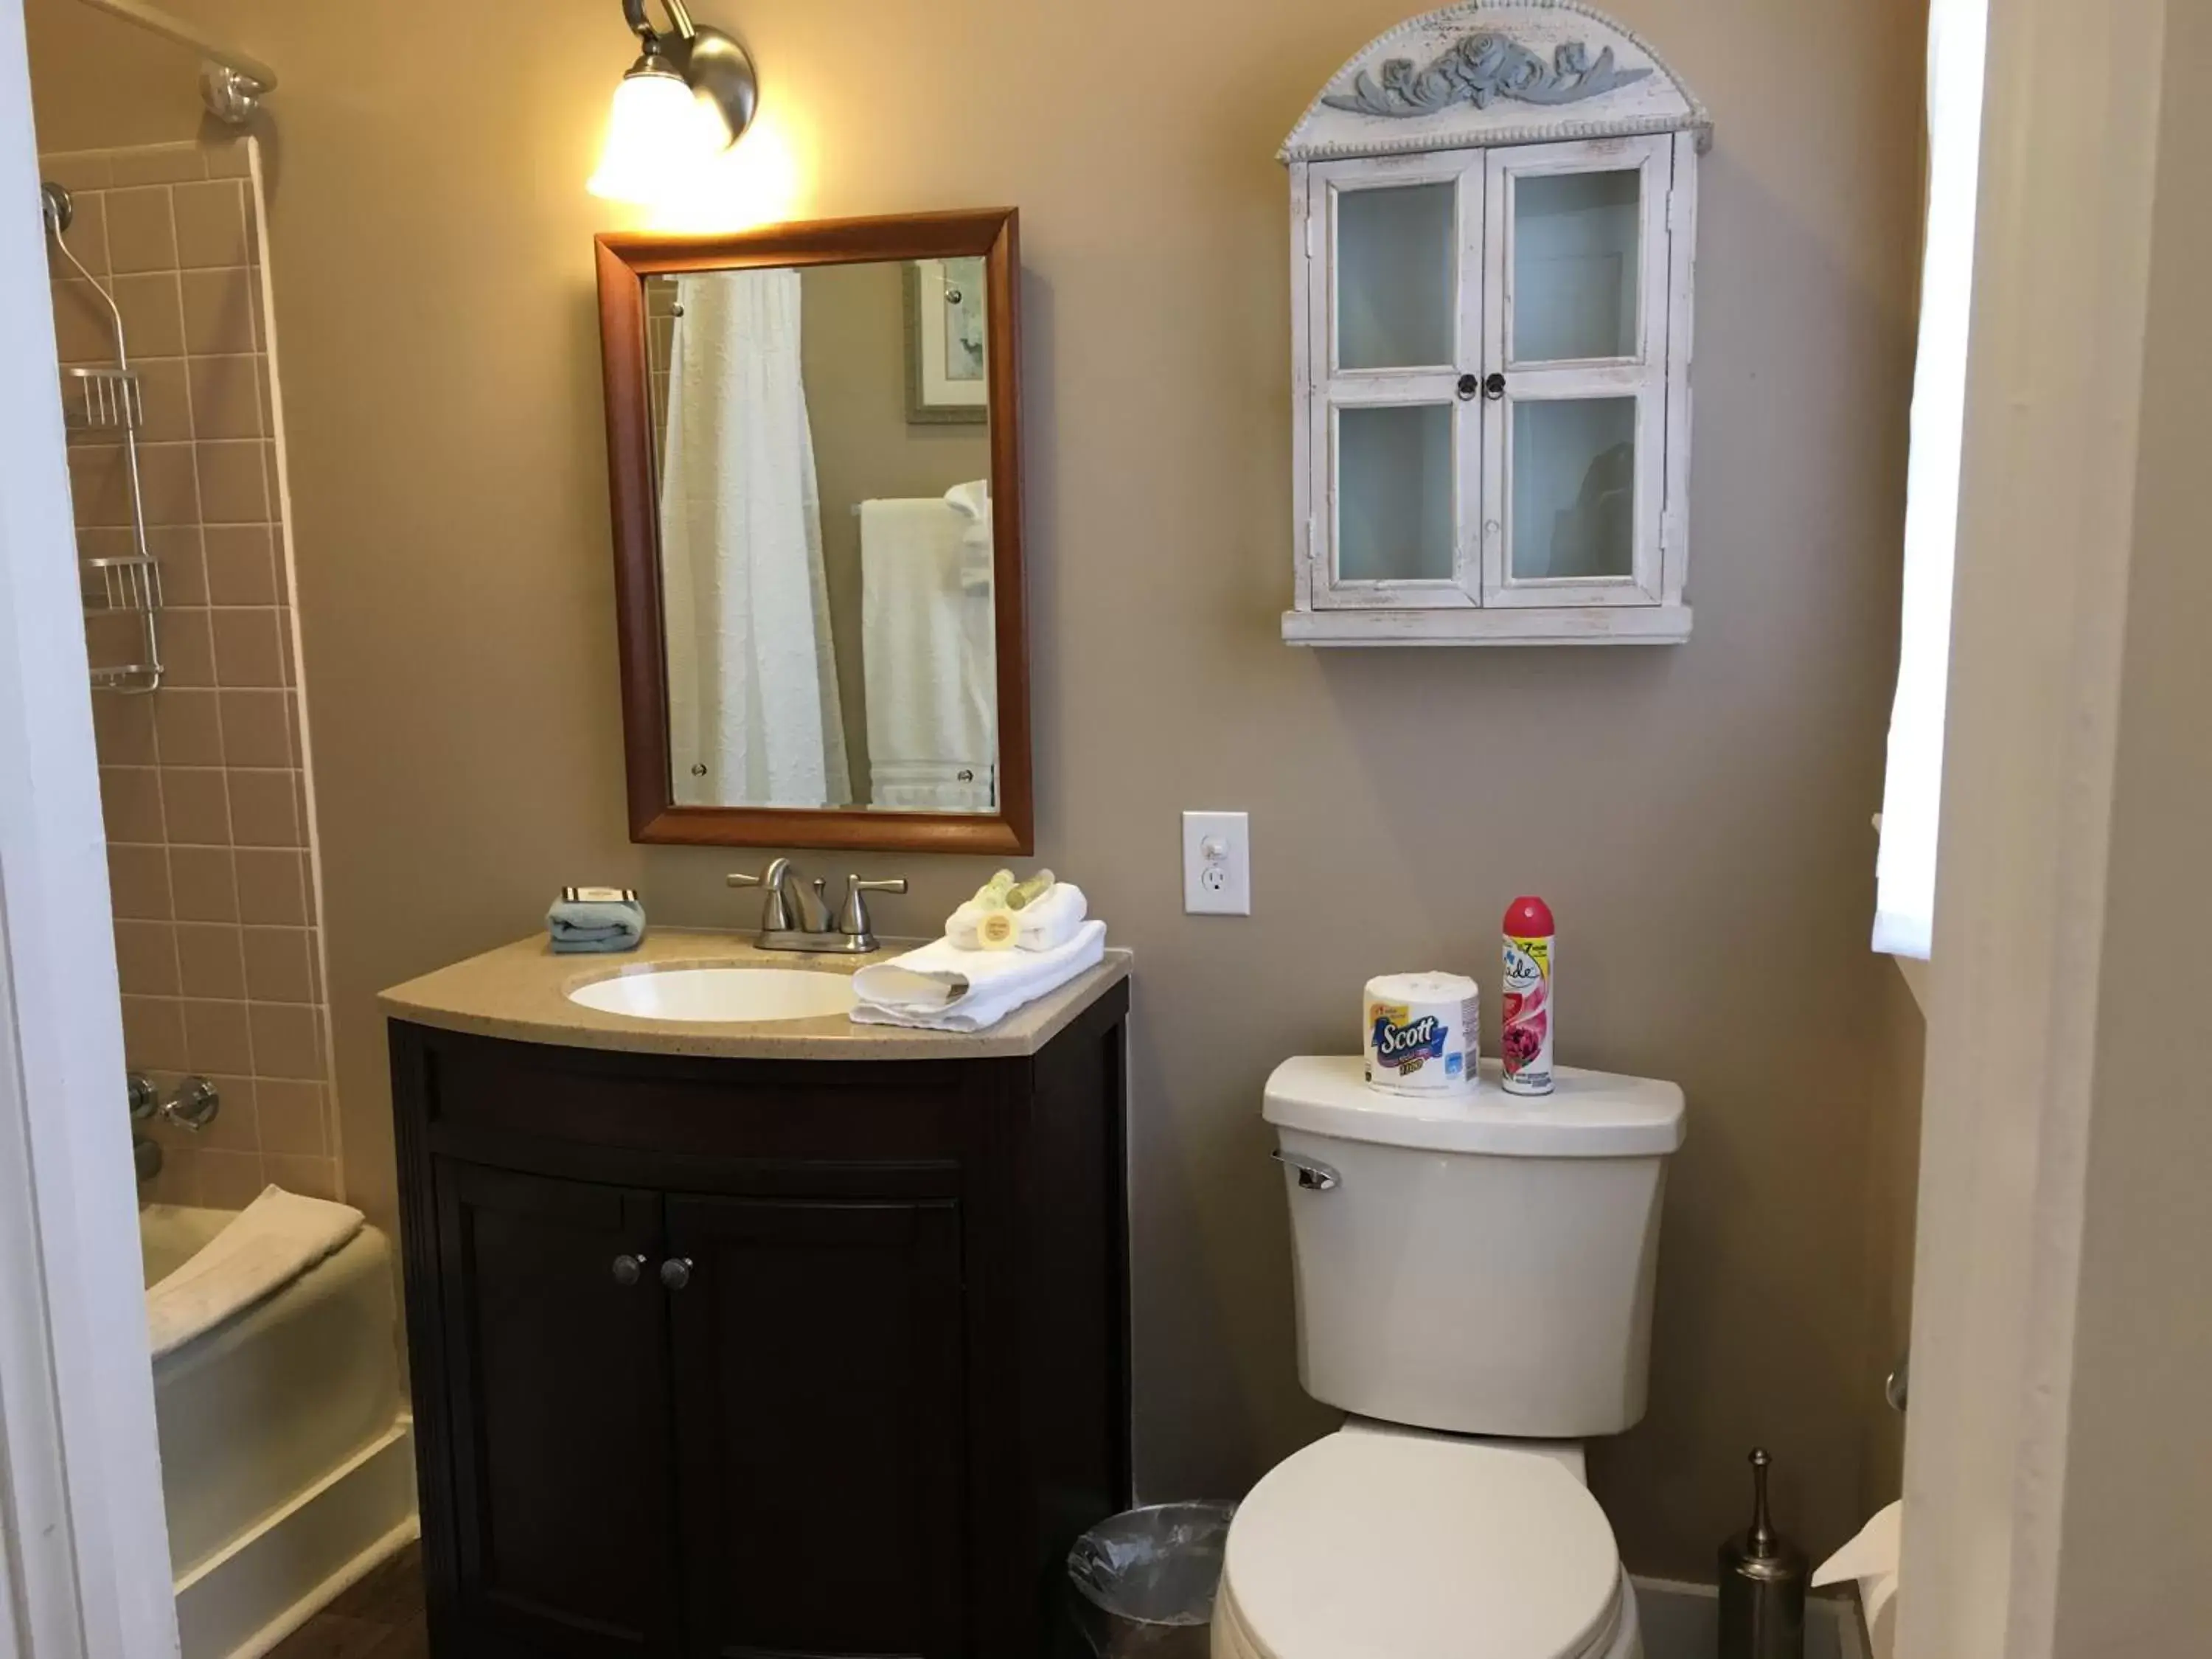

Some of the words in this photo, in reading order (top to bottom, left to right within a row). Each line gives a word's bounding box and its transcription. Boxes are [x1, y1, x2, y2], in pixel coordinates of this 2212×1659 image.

[1523, 942, 1533, 953] 7
[1505, 958, 1540, 978] ade
[1381, 1018, 1434, 1054] Scott
